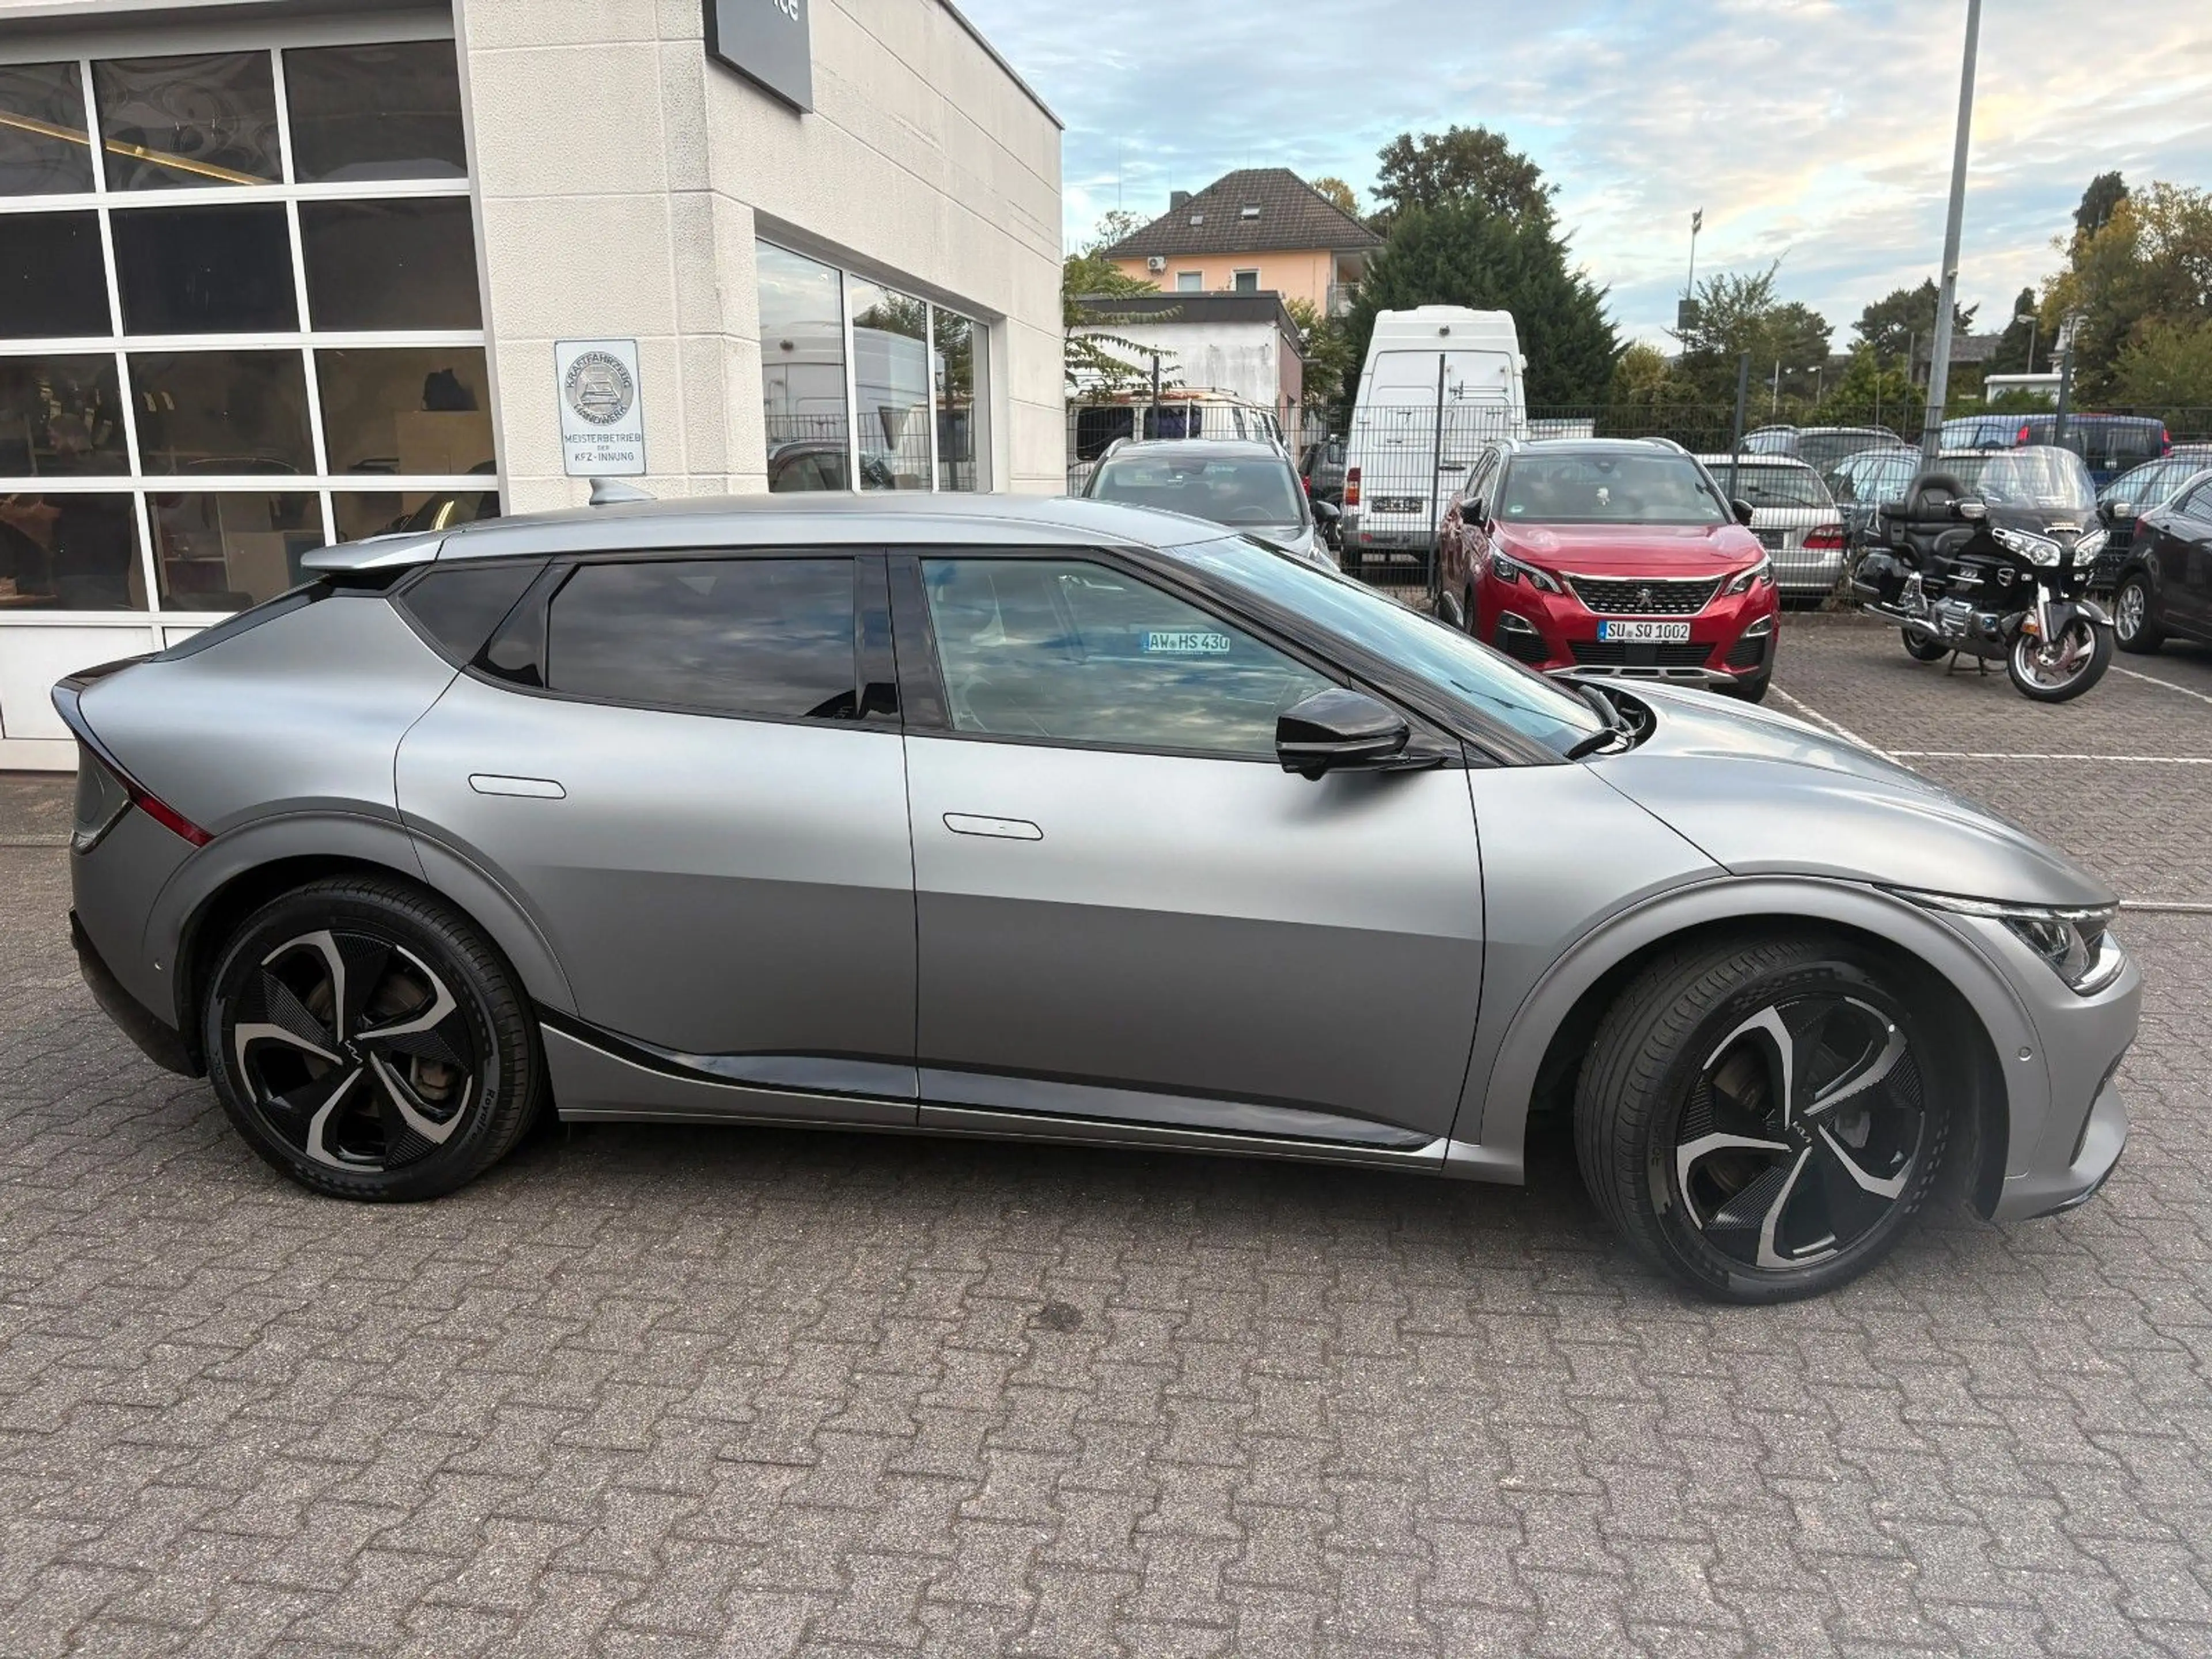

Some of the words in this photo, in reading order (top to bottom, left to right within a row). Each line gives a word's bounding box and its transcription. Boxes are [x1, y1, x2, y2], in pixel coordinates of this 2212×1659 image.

[566, 353, 632, 388] KRAFTFAHRZEUG
[573, 403, 628, 425] HANDWERK
[564, 433, 641, 443] MEISTERBETRIEB
[575, 452, 634, 461] KFZ-INNUNG
[1608, 623, 1625, 638] SU
[1635, 623, 1652, 638] SQ
[1654, 624, 1688, 639] 1002
[1150, 634, 1169, 648] AW
[1179, 634, 1198, 649] HS
[1201, 634, 1229, 649] 430
